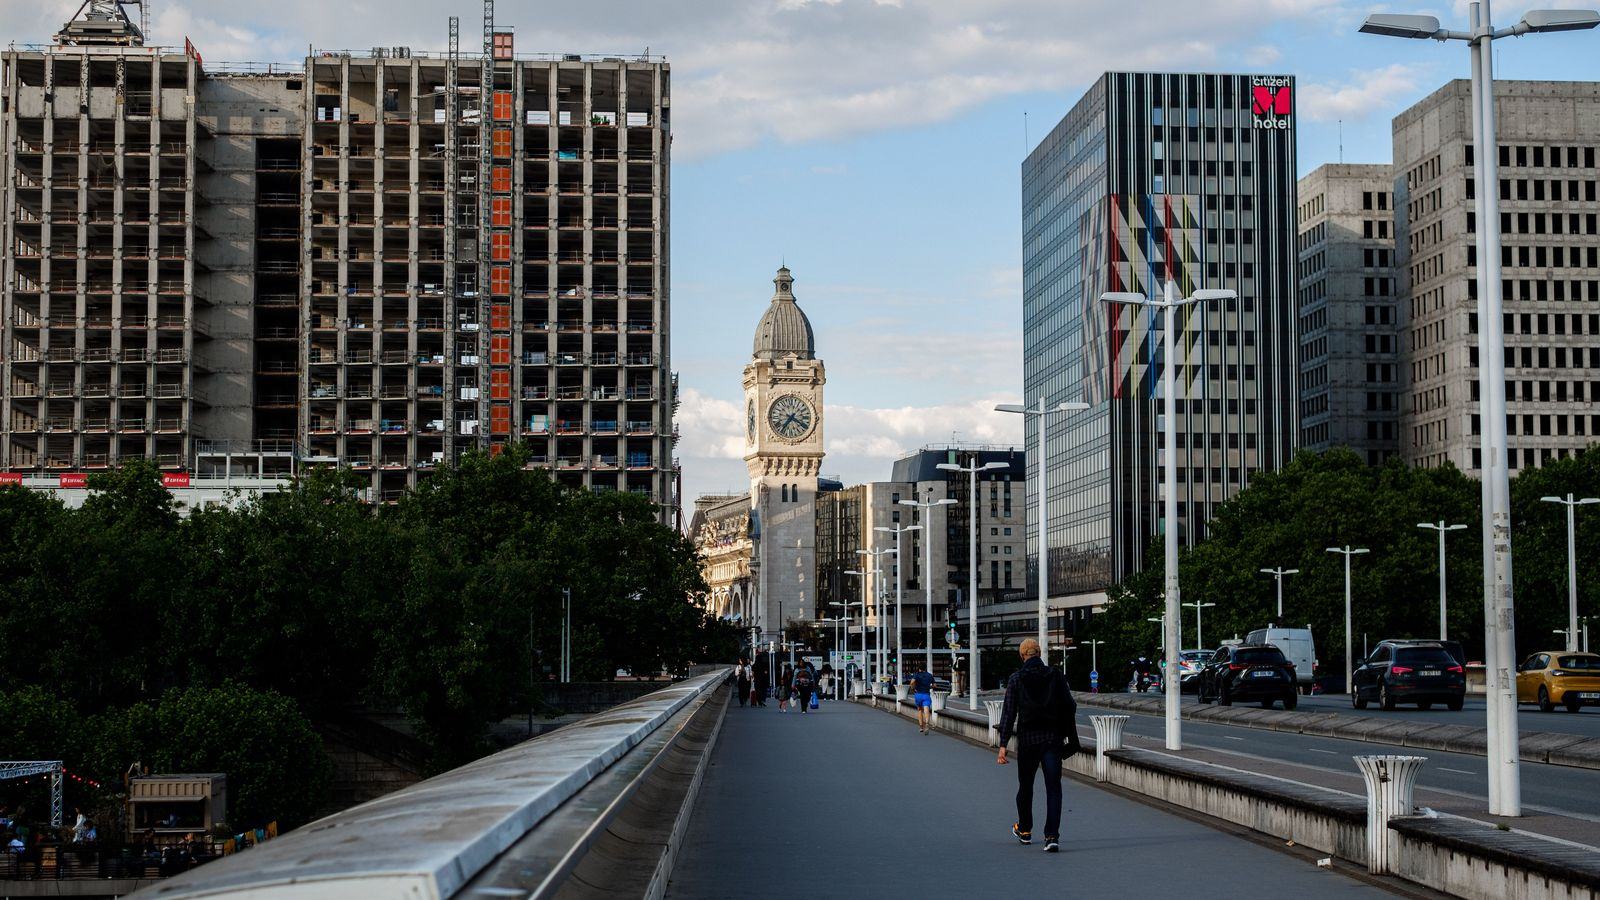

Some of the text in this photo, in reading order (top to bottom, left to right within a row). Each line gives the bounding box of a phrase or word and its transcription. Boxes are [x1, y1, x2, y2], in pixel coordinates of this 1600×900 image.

[1253, 76, 1290, 86] citizen
[1253, 86, 1290, 114] M
[1254, 115, 1290, 129] hotel
